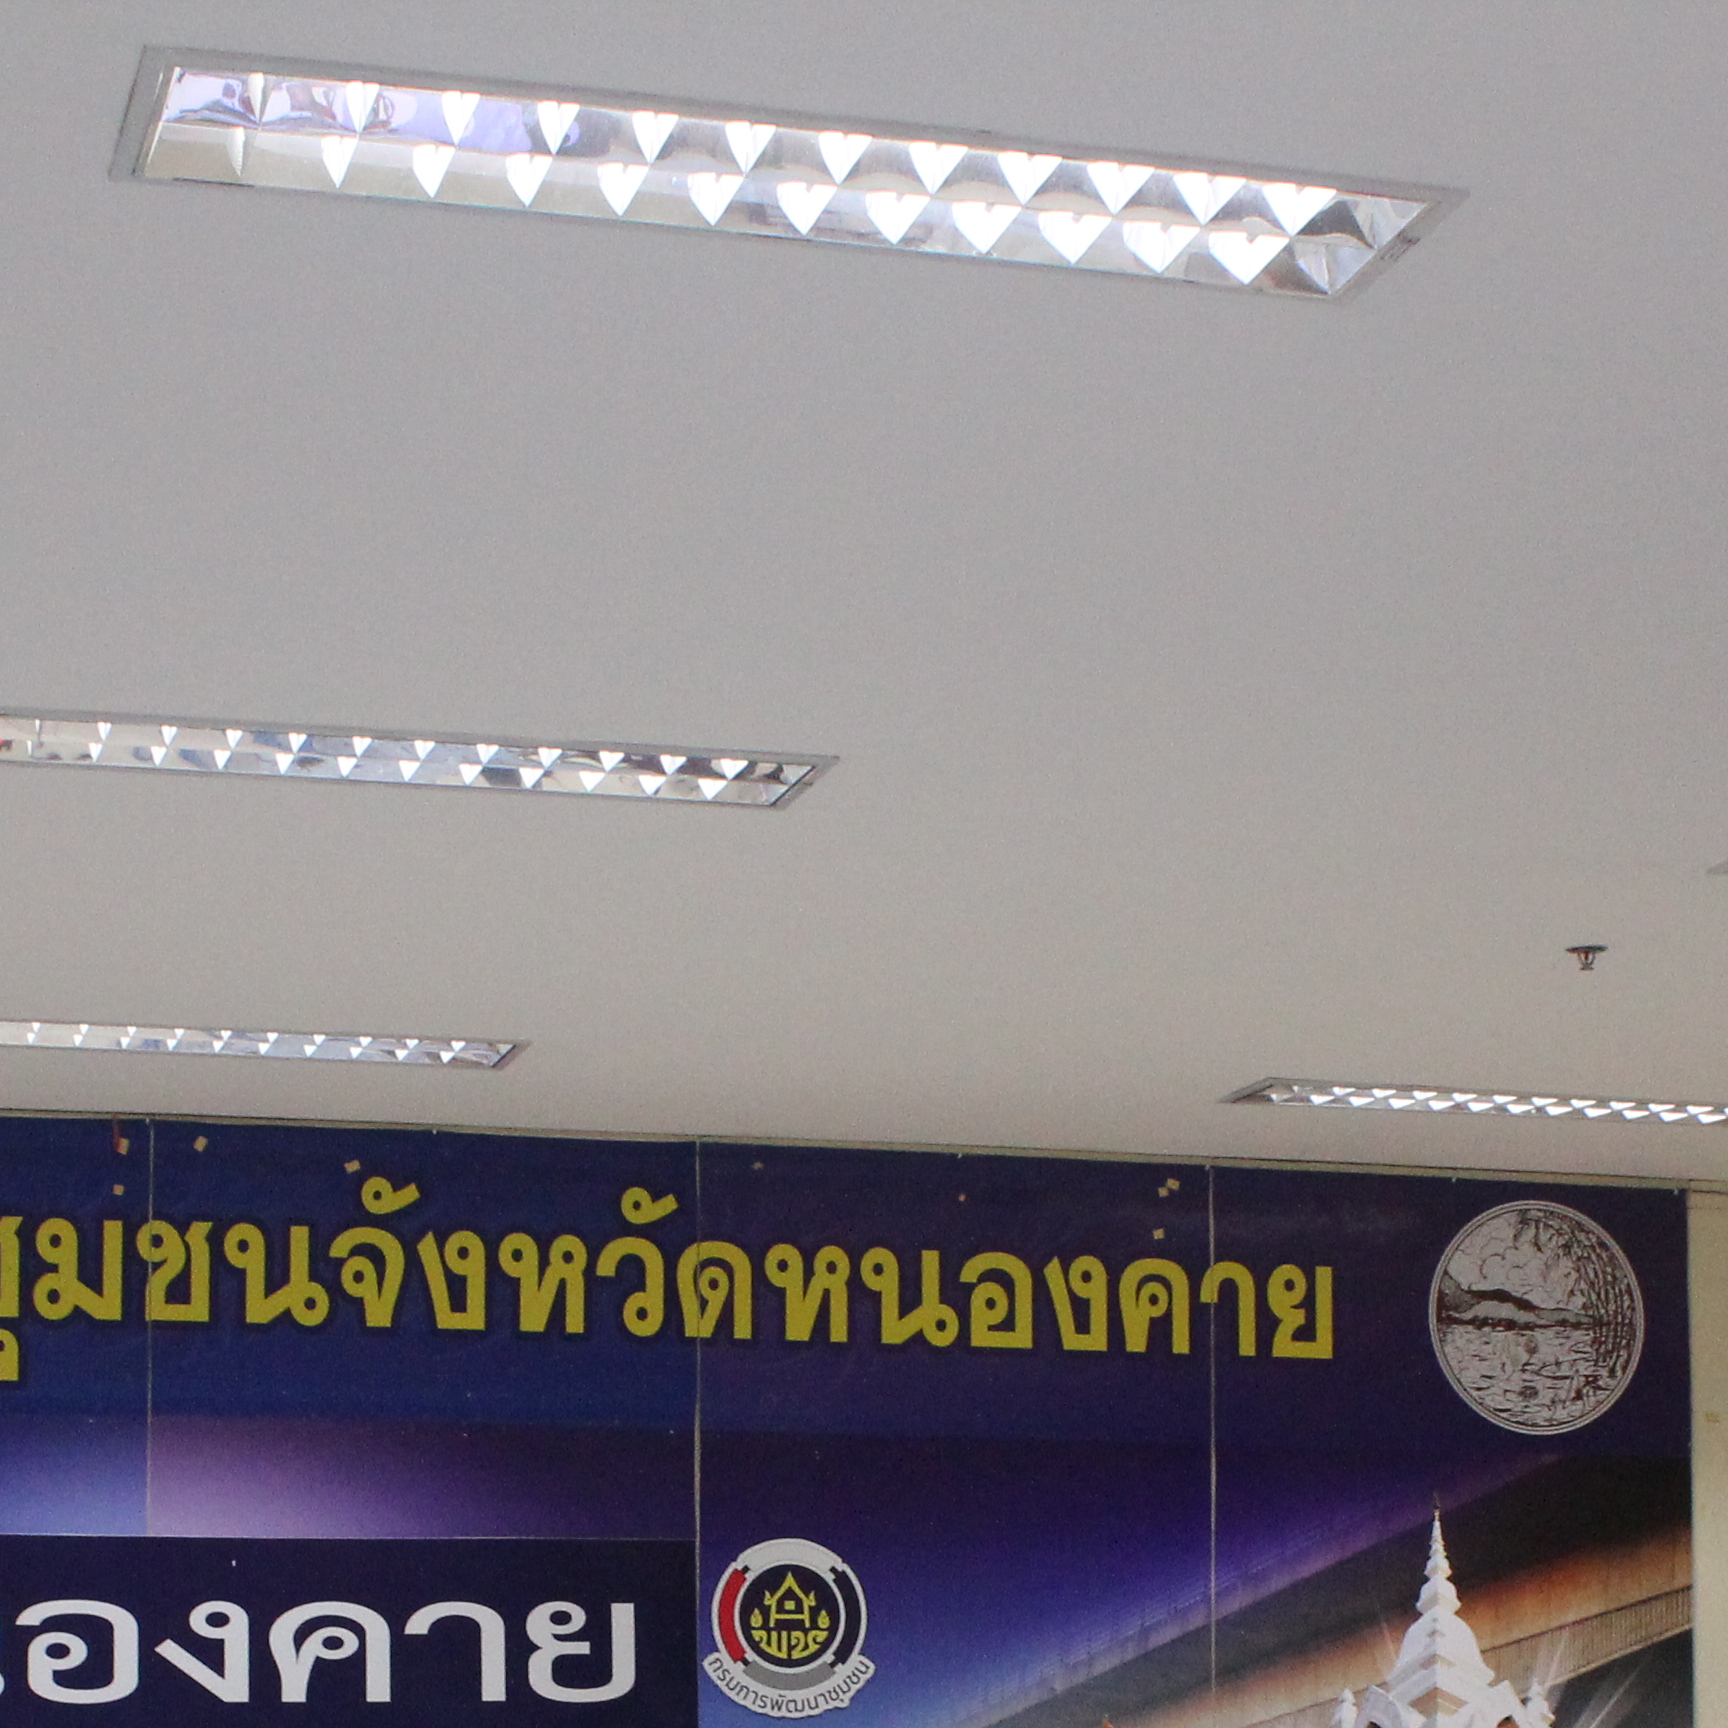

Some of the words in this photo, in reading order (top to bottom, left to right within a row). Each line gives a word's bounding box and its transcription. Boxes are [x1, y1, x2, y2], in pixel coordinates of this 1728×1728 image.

[708, 1657, 870, 1713] กรมการพัฒนาชุมชน
